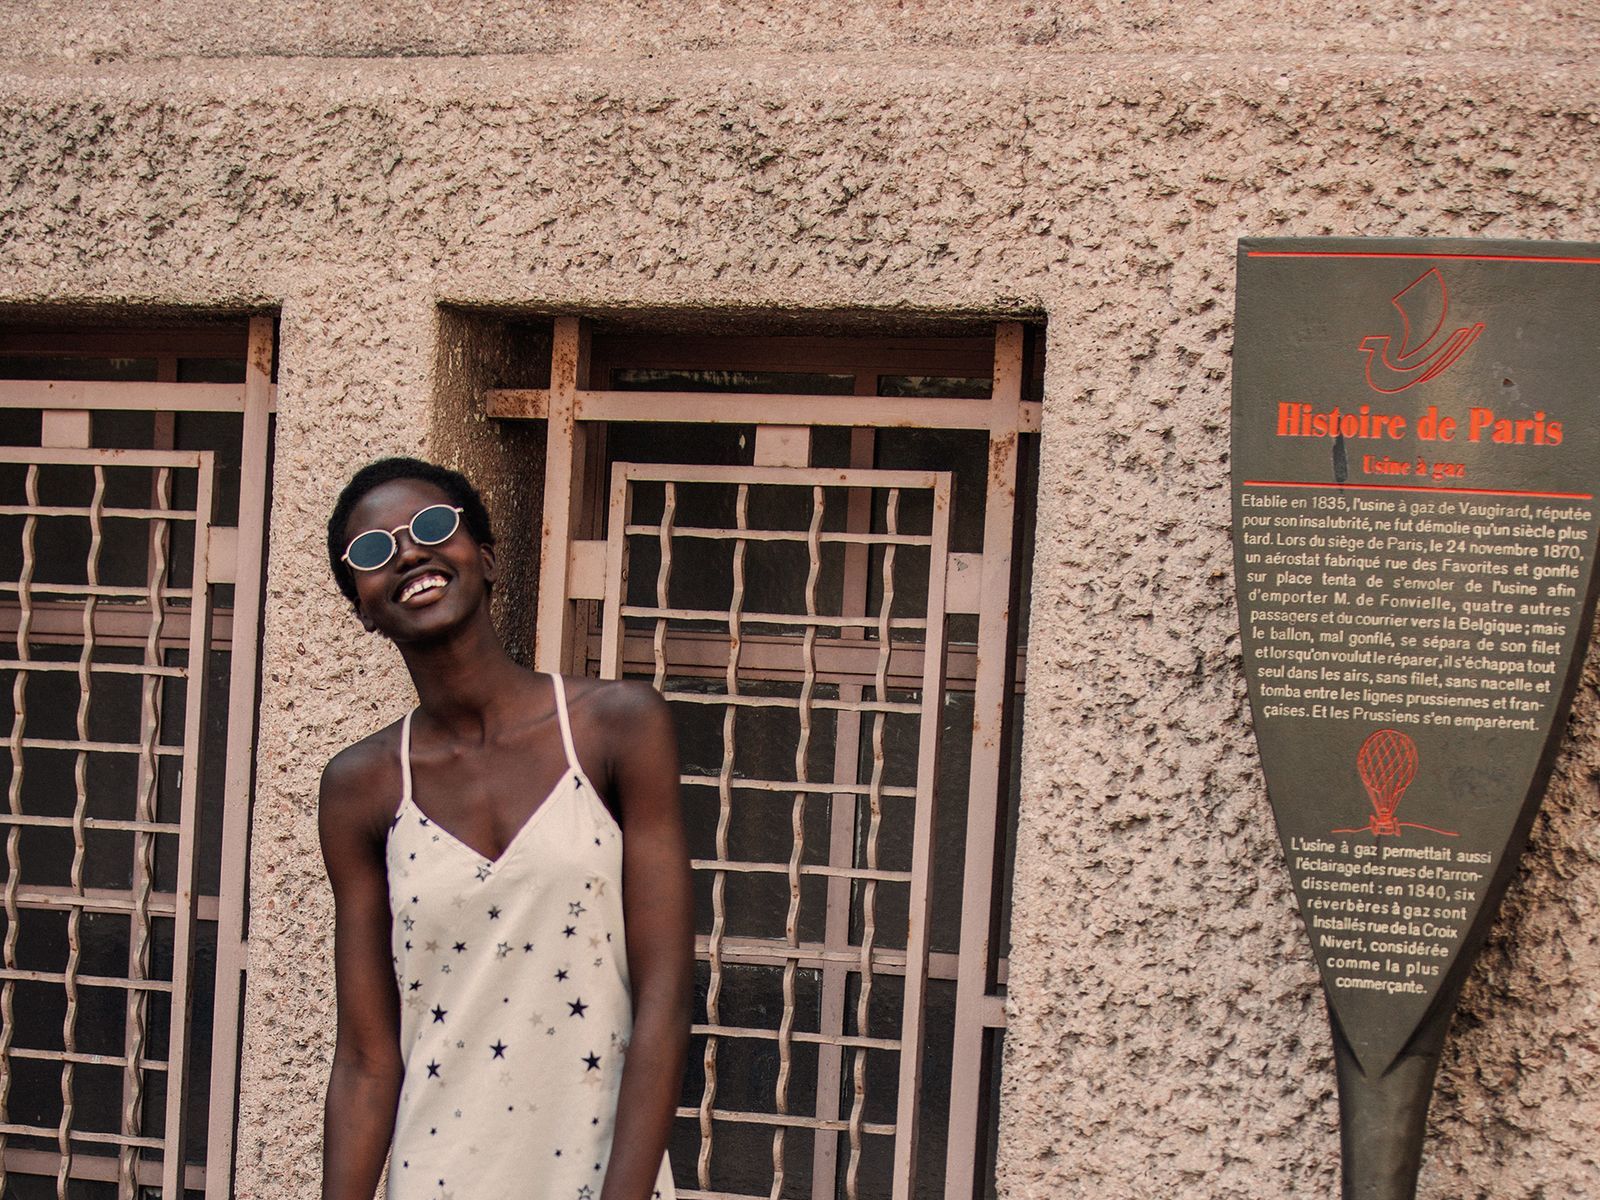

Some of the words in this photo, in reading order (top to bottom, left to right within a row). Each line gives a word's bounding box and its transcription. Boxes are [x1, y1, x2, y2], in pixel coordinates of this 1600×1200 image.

[1276, 401, 1407, 440] Histoire
[1416, 406, 1457, 440] de
[1468, 407, 1563, 446] Paris
[1363, 455, 1410, 476] Usine
[1416, 456, 1427, 476] à
[1432, 460, 1466, 481] gaz
[1241, 493, 1287, 508] Etablie
[1290, 498, 1307, 508] en
[1312, 496, 1350, 512] 1835,
[1352, 497, 1395, 512] l'usine
[1398, 499, 1406, 512] à
[1410, 503, 1435, 516] gaz
[1437, 501, 1455, 514] de
[1458, 501, 1533, 520] Vaugirard,
[1535, 506, 1592, 522] réputée
[1242, 516, 1271, 529] pour
[1273, 517, 1297, 527] son
[1299, 514, 1373, 532] insalubrité,
[1374, 520, 1391, 531] ne
[1394, 517, 1413, 532] fut
[1415, 519, 1470, 534] démolie
[1472, 522, 1510, 539] qu'un
[1512, 524, 1555, 538] siècle
[1557, 526, 1587, 542] plus
[1243, 532, 1274, 545] tard.
[1276, 532, 1306, 546] Lors
[1309, 534, 1325, 547] du
[1327, 535, 1364, 552] siège
[1367, 536, 1384, 549] de
[1387, 536, 1427, 554] Paris,
[1429, 539, 1443, 552] le
[1446, 539, 1466, 553] 24
[1469, 543, 1538, 557] novembre
[1543, 544, 1584, 561] 1870,
[1245, 553, 1261, 563] un
[1264, 551, 1320, 566] aérostat
[1324, 553, 1380, 571] fabriqué
[1385, 559, 1407, 569] rue
[1412, 557, 1437, 571] des
[1441, 558, 1508, 575] Favorites
[1513, 563, 1528, 576] et
[1532, 564, 1579, 580] gonflé
[1246, 572, 1267, 582] sur
[1276, 570, 1312, 586] place
[1321, 572, 1356, 586] tenta
[1366, 574, 1383, 588] de
[1393, 576, 1455, 591] s'envoler
[1464, 579, 1482, 592] de
[1492, 580, 1537, 595] l'usine
[1547, 583, 1575, 597] afin
[1248, 588, 1328, 605] d'emporter
[1334, 591, 1350, 605] M.
[1355, 592, 1374, 606] de
[1380, 593, 1456, 612] Fonvielle,
[1462, 599, 1513, 614] quatre
[1519, 602, 1570, 616] autres
[1250, 610, 1318, 625] passagers
[1320, 611, 1334, 623] et
[1336, 611, 1353, 624] du
[1355, 613, 1408, 627] courrier
[1410, 617, 1441, 629] vers
[1442, 616, 1456, 630] la
[1252, 625, 1265, 639] le
[1270, 626, 1314, 643] ballon,
[1319, 630, 1344, 643] mal
[1348, 631, 1395, 648] gonflé,
[1400, 636, 1417, 647] se
[1422, 635, 1470, 651] sépara
[1476, 637, 1495, 651] de
[1500, 641, 1526, 652] son
[1531, 639, 1561, 655] filet
[1254, 646, 1268, 658] et
[1270, 646, 1330, 663] lorsqu'on
[1330, 649, 1372, 663] voulut
[1373, 651, 1386, 664] le
[1387, 652, 1443, 669] réparer,
[1443, 654, 1453, 667] il
[1453, 655, 1525, 674] s'échappa
[1526, 659, 1556, 674] tout
[1257, 664, 1285, 678] seul
[1286, 666, 1318, 680] dans
[1320, 666, 1340, 681] les
[1342, 668, 1373, 685] airs,
[1375, 673, 1407, 684] sans
[1410, 671, 1443, 688] filet,
[1444, 677, 1477, 688] sans
[1480, 678, 1533, 692] nacelle
[1535, 680, 1550, 693] et
[1260, 683, 1301, 698] tomba
[1303, 686, 1338, 700] entre
[1340, 687, 1360, 701] les
[1363, 688, 1403, 706] lignes
[1406, 693, 1489, 708] prussiennes
[1492, 697, 1507, 709] et
[1509, 696, 1544, 711] fran-
[1263, 703, 1309, 718] çaises.
[1312, 704, 1327, 718] Et
[1330, 705, 1349, 719] les
[1353, 706, 1420, 723] Prussiens
[1423, 711, 1451, 725] s'en
[1453, 715, 1539, 731] emparèrent.
[1291, 837, 1335, 853] L'usine
[1340, 840, 1349, 854] à
[1354, 844, 1377, 859] gaz
[1382, 846, 1451, 861] permettait
[1456, 851, 1491, 863] aussi
[1295, 856, 1361, 877] l'éclairage
[1362, 861, 1386, 875] des
[1387, 866, 1416, 878] rues
[1417, 865, 1434, 879] de
[1435, 866, 1483, 882] l'arron-
[1384, 885, 1403, 895] en
[1407, 883, 1450, 902] 1840,
[1454, 887, 1475, 901] six
[1307, 896, 1389, 914] réverbères
[1391, 901, 1400, 915] à
[1403, 905, 1430, 920] gaz
[1433, 907, 1467, 920] sont
[1367, 922, 1389, 933] rue
[1389, 921, 1407, 935] de
[1407, 921, 1421, 936] la
[1422, 922, 1458, 938] Croix
[1320, 934, 1367, 953] Nivert,
[1369, 940, 1449, 957] considérée
[1326, 957, 1380, 971] comme
[1385, 958, 1400, 973] la
[1405, 961, 1439, 977] plus
[1335, 976, 1427, 994] commerçante.
